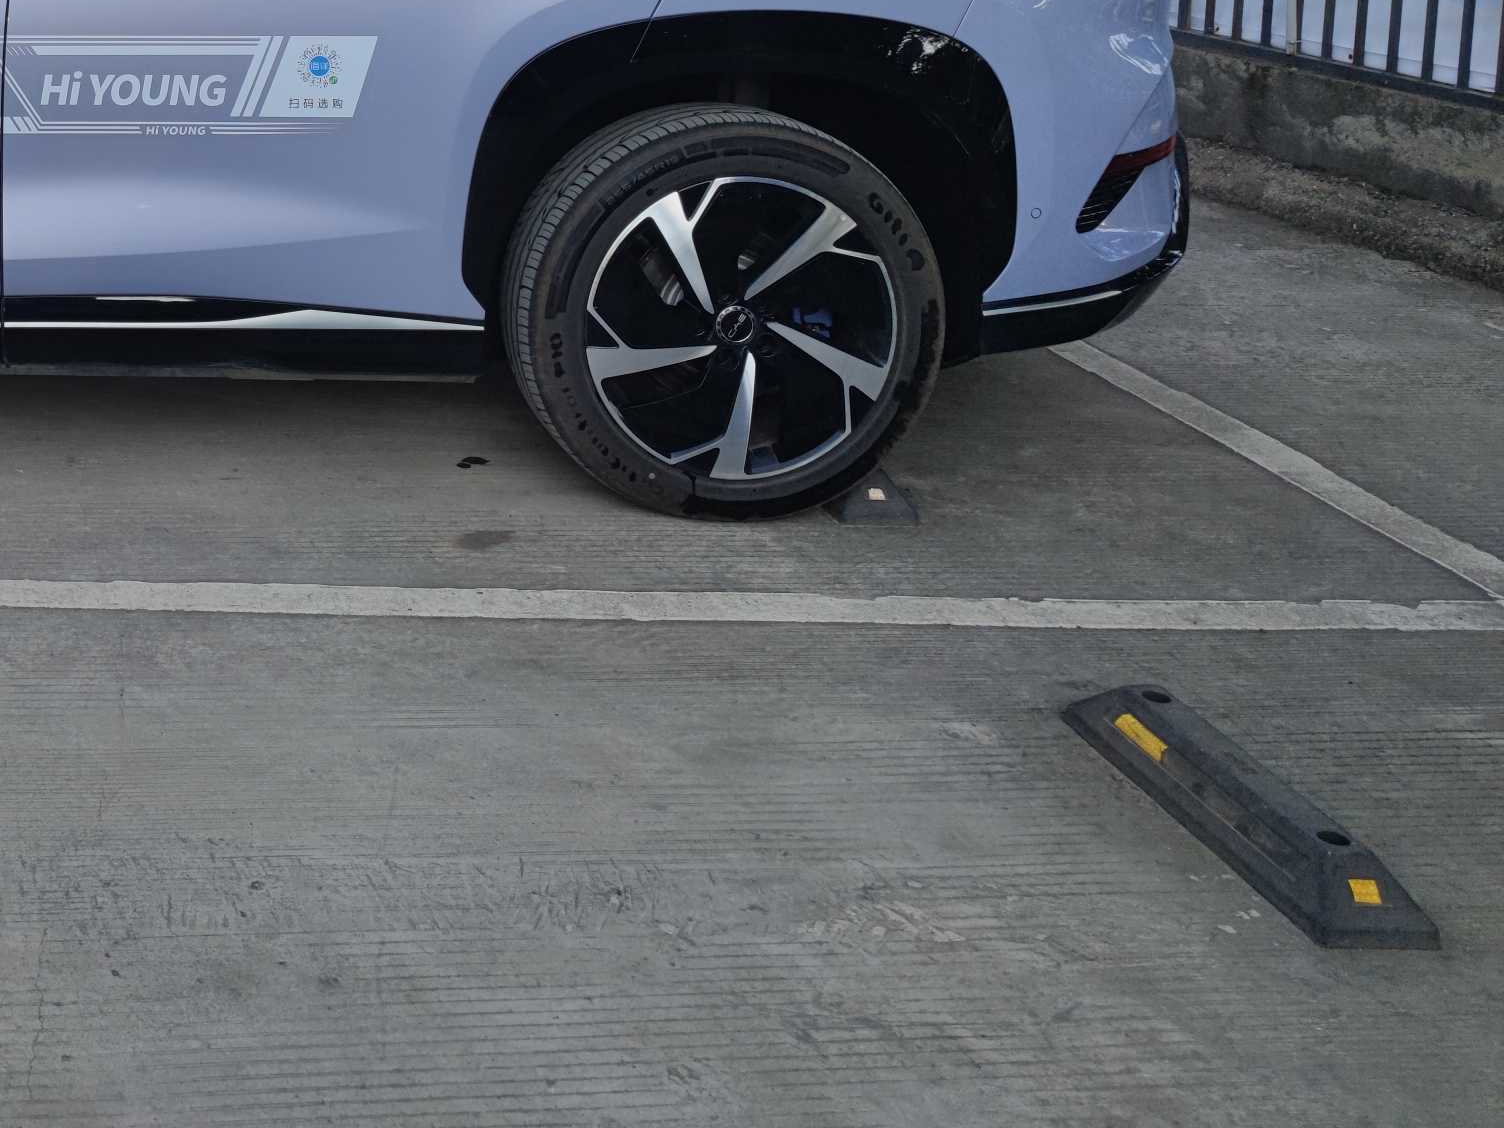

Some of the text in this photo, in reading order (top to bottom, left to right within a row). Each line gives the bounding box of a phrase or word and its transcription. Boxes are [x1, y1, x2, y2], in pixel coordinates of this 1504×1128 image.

[39, 71, 228, 108] Hi YOUNG
[288, 98, 344, 110] 扫码选购
[146, 124, 207, 137] Hi YOUNG
